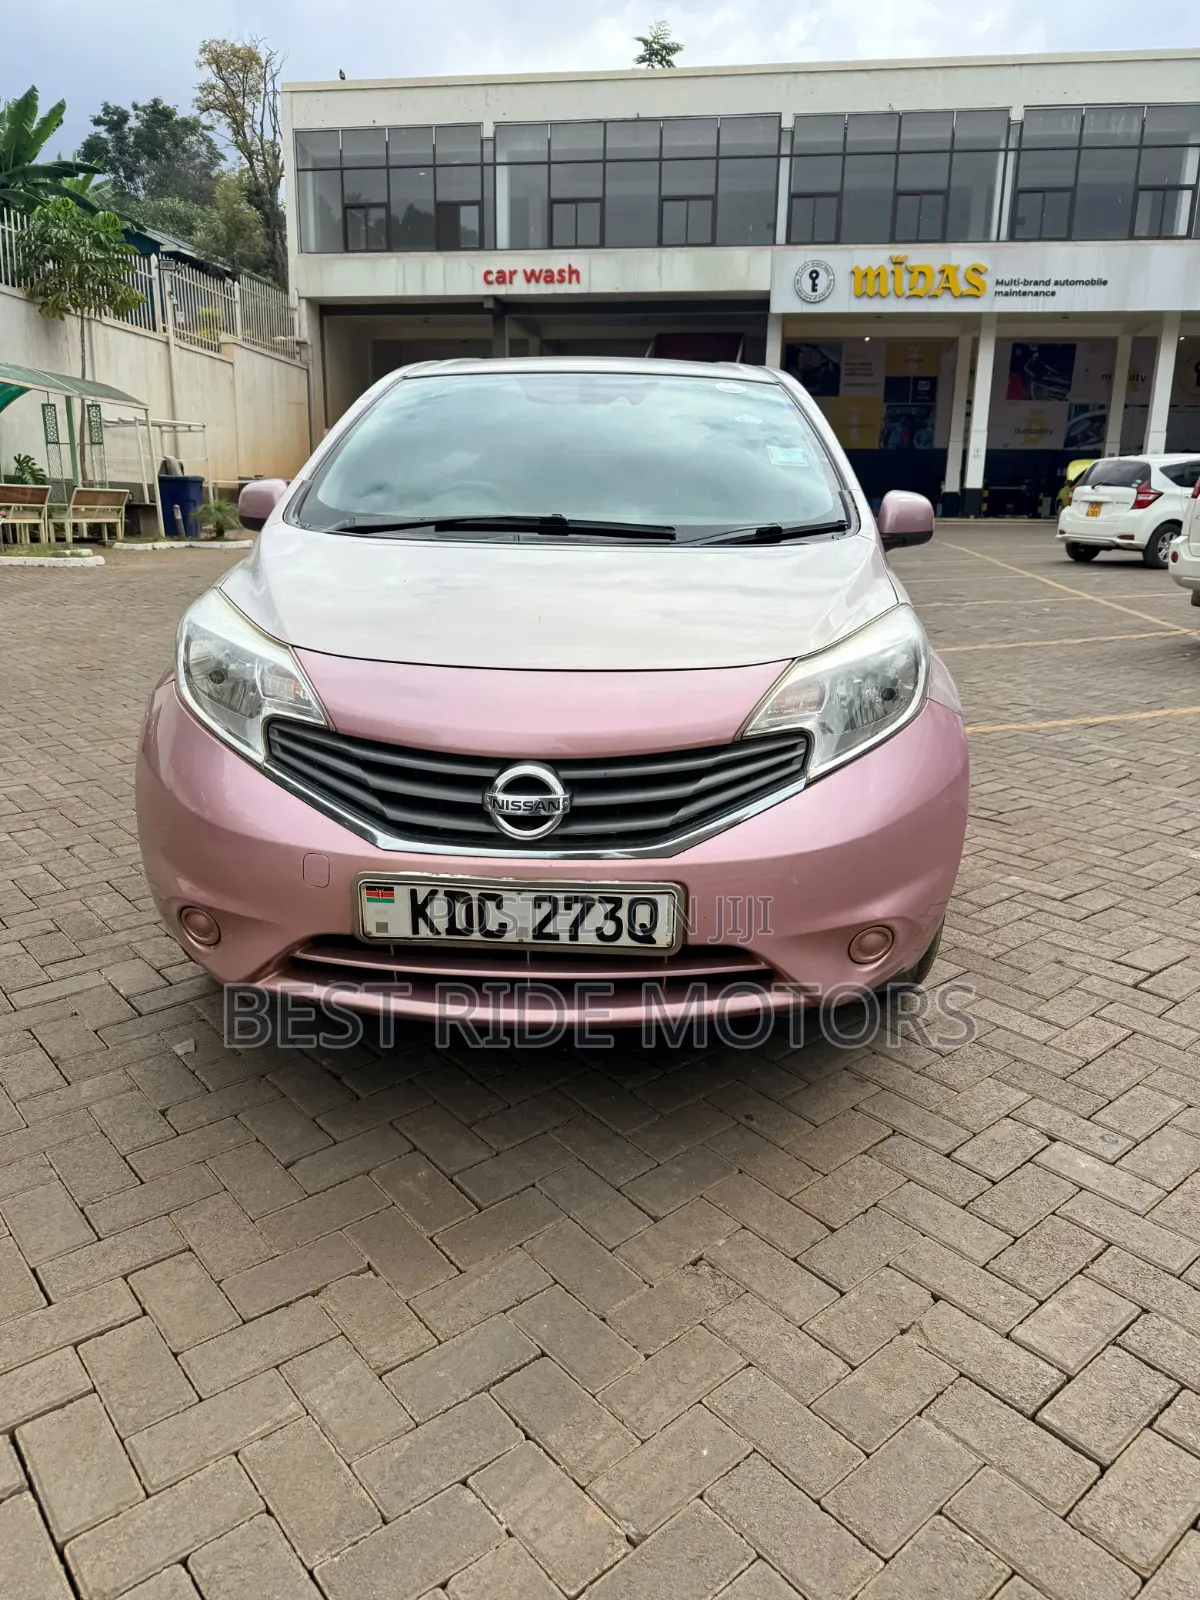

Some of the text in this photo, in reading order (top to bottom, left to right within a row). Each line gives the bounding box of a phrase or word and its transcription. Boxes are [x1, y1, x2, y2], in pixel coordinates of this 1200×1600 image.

[483, 263, 581, 285] car wash
[995, 277, 1109, 287] Multi-brand automobile
[994, 288, 1057, 297] maintenance
[492, 798, 561, 812] NISSAN
[409, 888, 508, 939] KDC
[531, 894, 659, 944] 273Q
